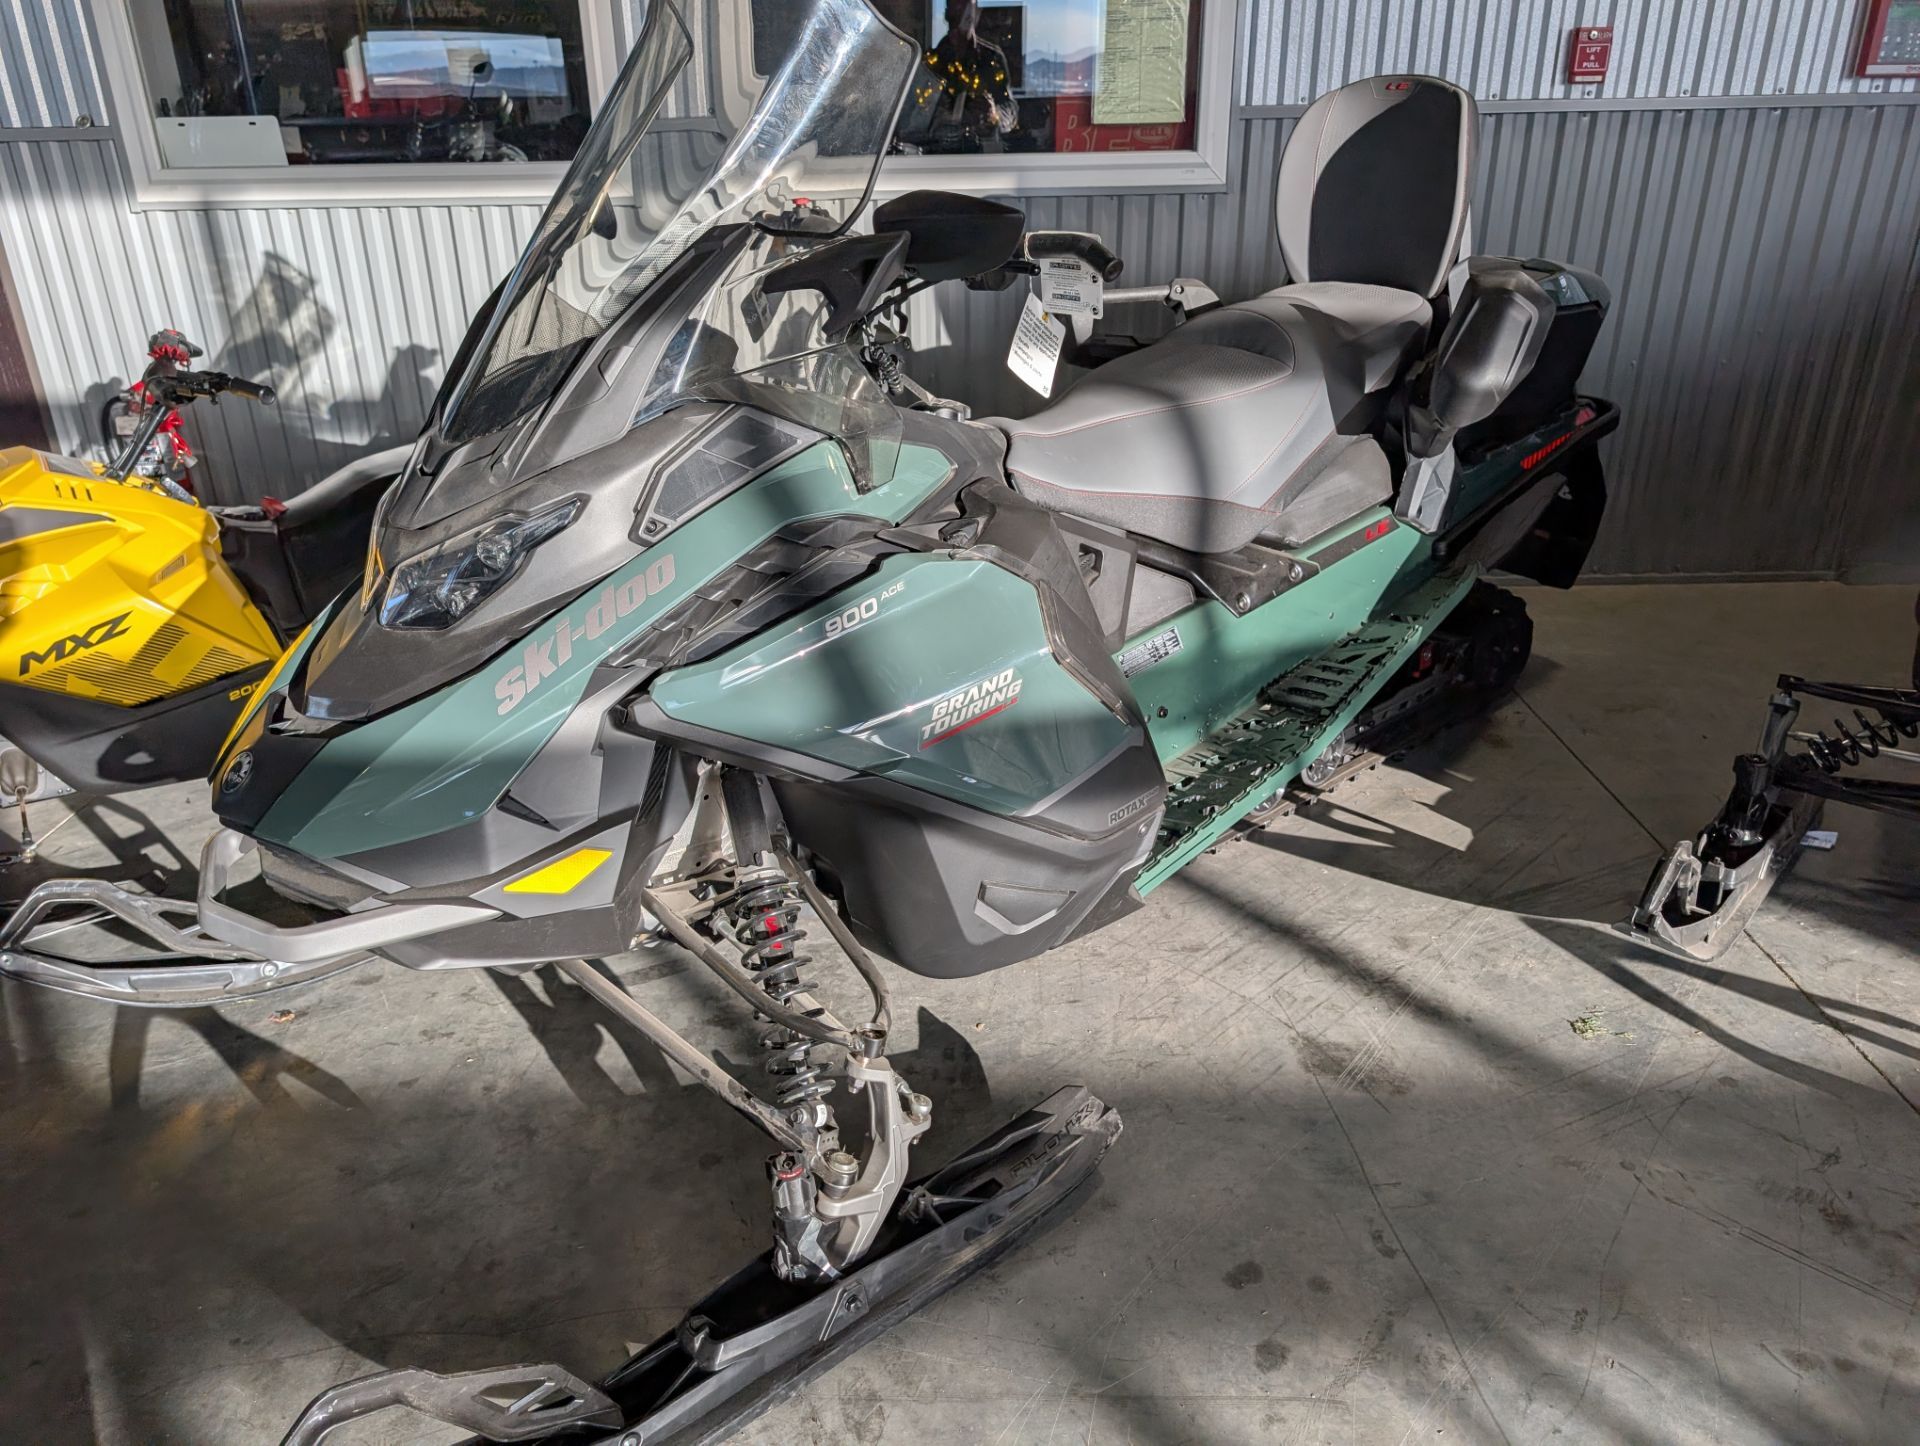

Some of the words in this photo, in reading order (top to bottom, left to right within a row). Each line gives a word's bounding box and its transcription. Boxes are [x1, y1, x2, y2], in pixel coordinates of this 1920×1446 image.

[1385, 82, 1409, 91] LE
[1365, 518, 1390, 541] LE
[825, 597, 878, 638] 900
[881, 581, 905, 601] ACE
[19, 610, 133, 677] MXZ
[922, 679, 1023, 740] TOURING
[932, 668, 1014, 721] GRAND
[1109, 796, 1146, 825] ROTAX
